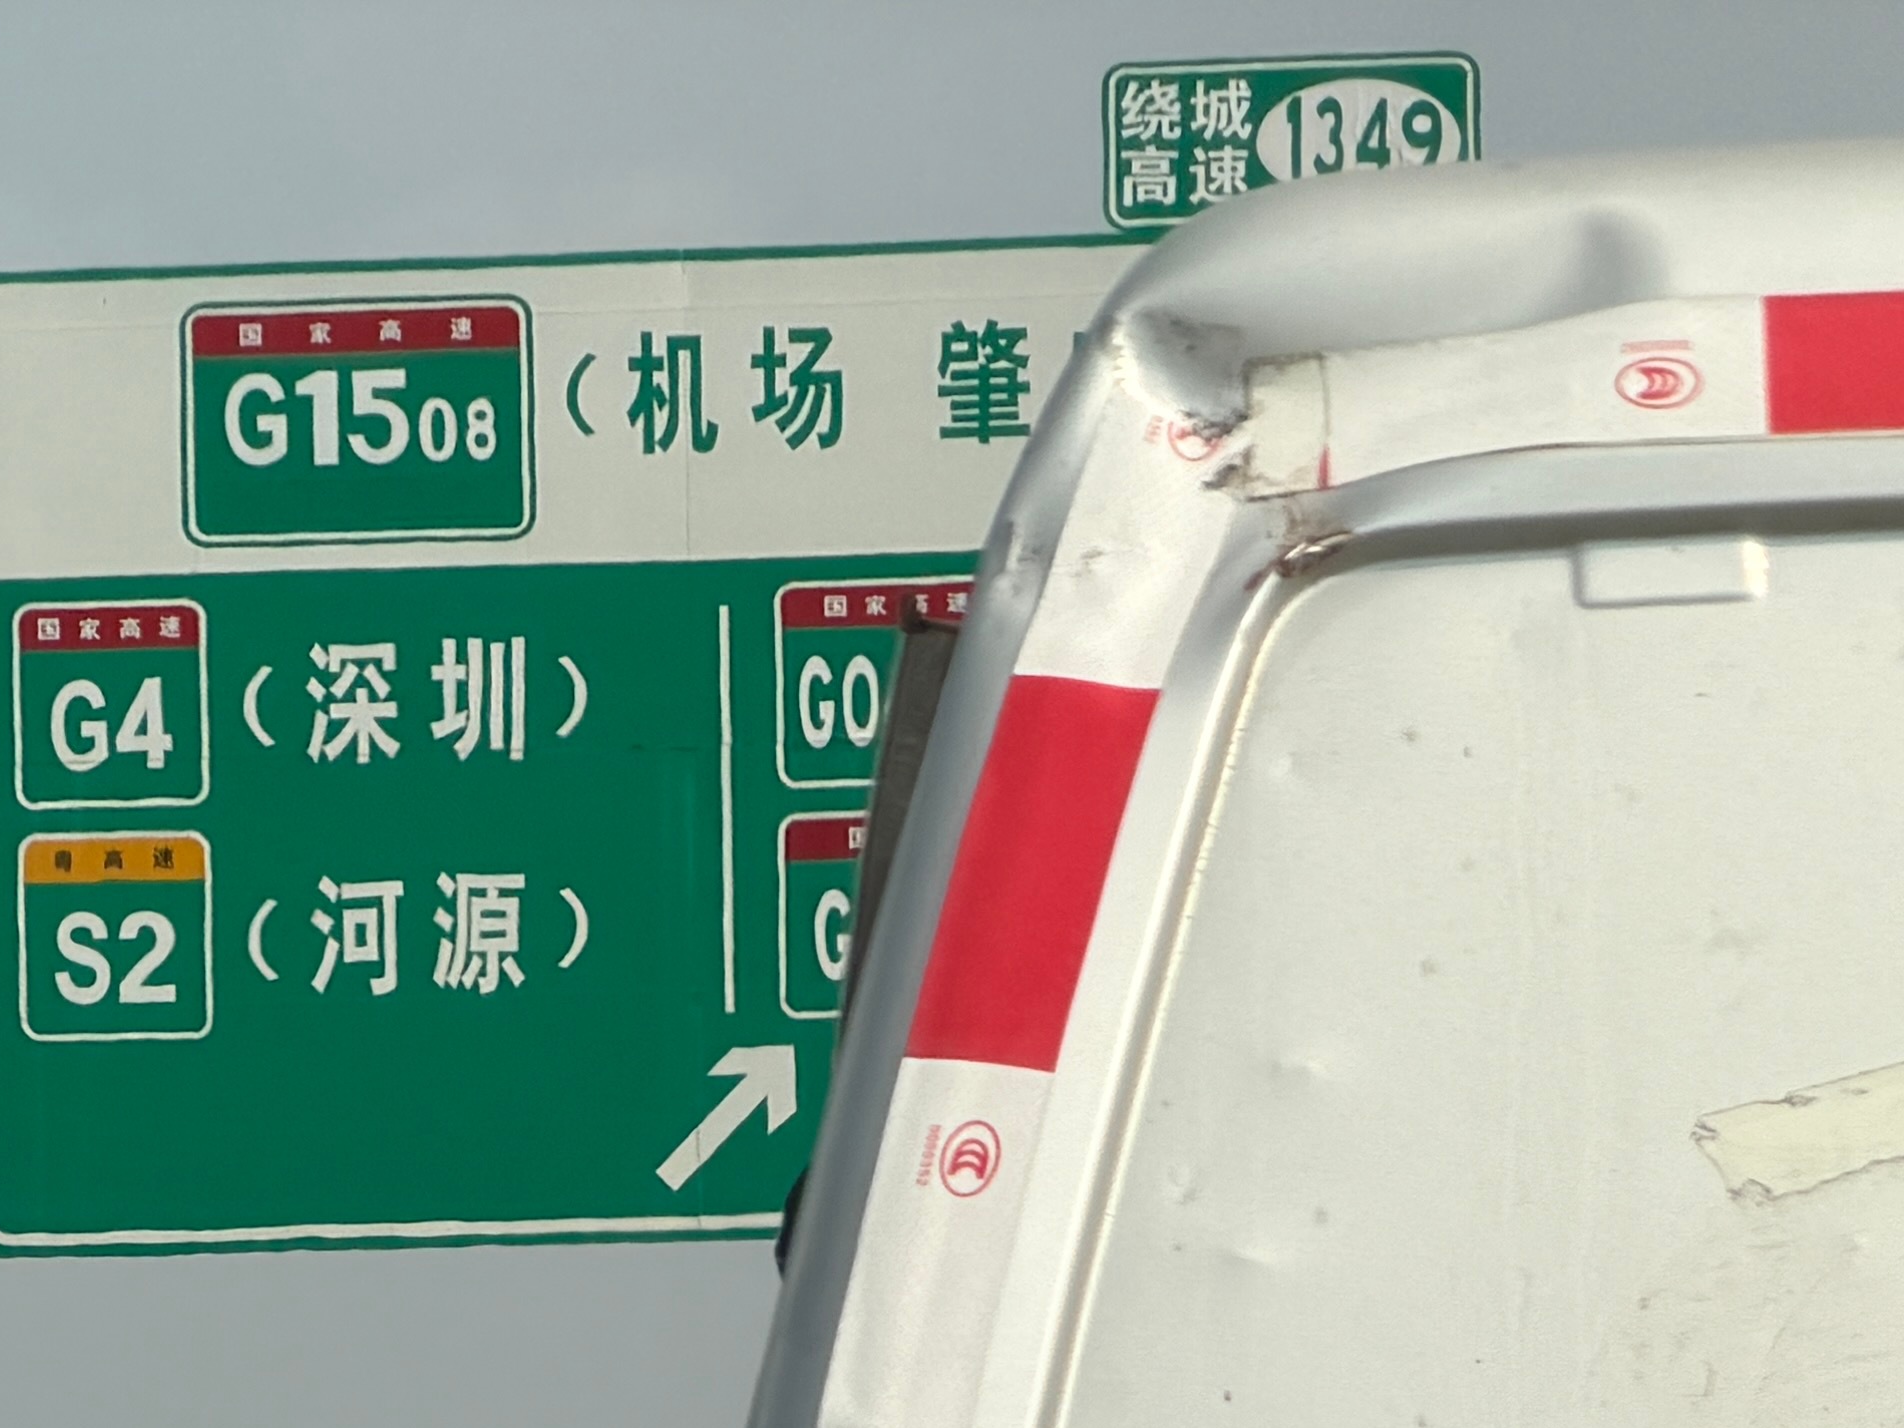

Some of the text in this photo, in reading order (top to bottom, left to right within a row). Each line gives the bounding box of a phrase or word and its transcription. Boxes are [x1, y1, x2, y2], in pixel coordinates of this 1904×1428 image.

[1120, 77, 1252, 141] 绕城
[1286, 92, 1443, 179] 1349
[1120, 145, 1249, 208] 高速
[239, 316, 473, 347] 国家高速
[224, 368, 497, 467] G1508
[937, 319, 1090, 444] 肇
[37, 616, 181, 641] 国家高速
[51, 676, 174, 772] G4
[242, 636, 589, 766] （深圳）
[54, 910, 177, 1005] S2
[246, 871, 591, 999] （河源）
